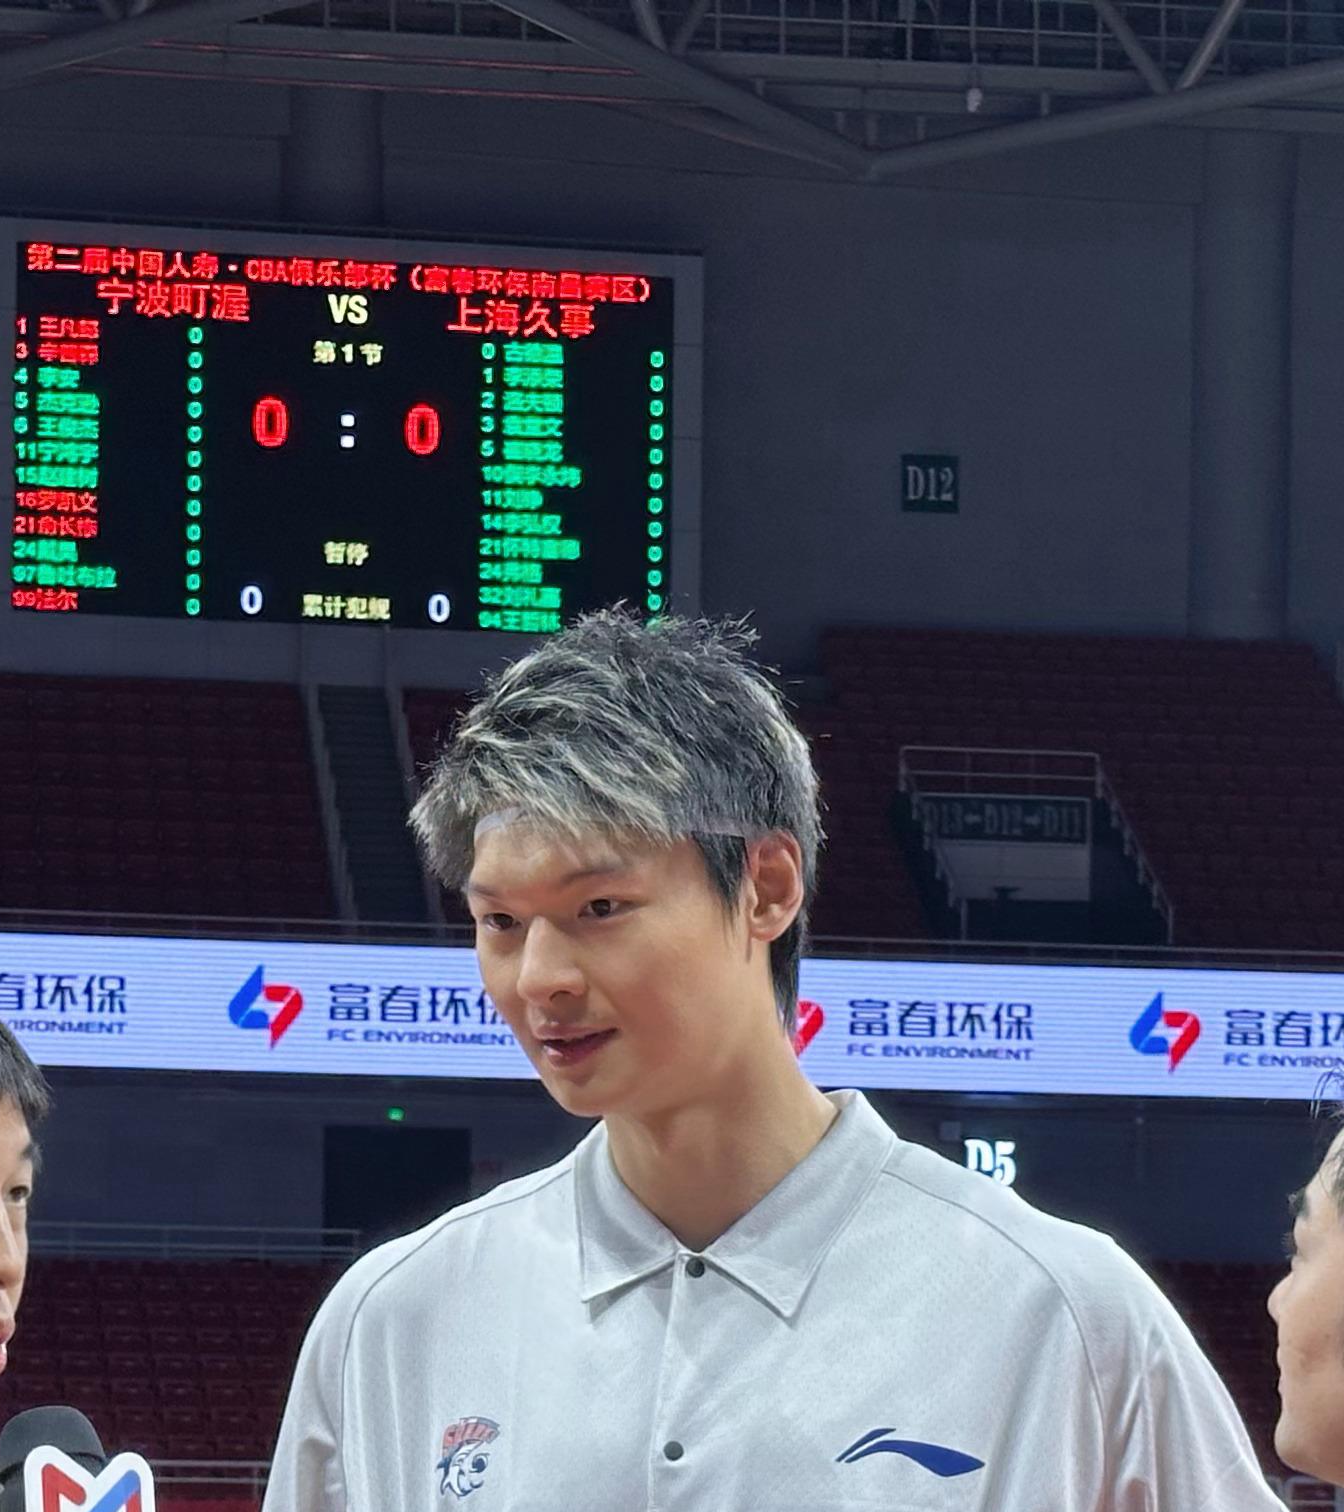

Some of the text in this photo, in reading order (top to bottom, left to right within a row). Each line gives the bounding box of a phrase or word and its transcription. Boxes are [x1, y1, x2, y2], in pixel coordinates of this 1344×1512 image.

[96, 277, 251, 322] 宁波町渥
[327, 293, 369, 325] VS
[447, 297, 596, 338] 上海久事
[15, 316, 27, 335] 1
[187, 326, 204, 345] 0
[15, 341, 29, 359] 3
[187, 351, 204, 369] 0
[649, 350, 665, 369] 0
[187, 375, 203, 395] 0
[482, 367, 493, 384] 1
[649, 374, 664, 393] 0
[187, 401, 203, 419] 0
[480, 391, 495, 409] 2
[649, 399, 664, 417] 0
[187, 425, 203, 444] 0
[252, 395, 289, 448] 0
[404, 402, 441, 455] 0
[480, 415, 495, 433] 3
[649, 423, 664, 441] 0
[187, 450, 203, 468] 0
[648, 447, 664, 465] 0
[186, 474, 203, 492] 0
[648, 471, 664, 490] 0
[906, 464, 955, 502] D12
[186, 499, 202, 517] 0
[647, 497, 664, 515] 0
[186, 523, 201, 543] 0
[647, 521, 663, 539] 0
[186, 548, 201, 567] 0
[323, 541, 369, 566] 暂停
[647, 545, 663, 563] 0
[186, 573, 201, 591] 0
[647, 569, 663, 587] 0
[185, 597, 201, 616] 0
[240, 585, 451, 623] 0 累计犯规 0
[647, 593, 663, 612] 0
[848, 998, 1034, 1041] 富春环保
[327, 1028, 357, 1042] FC
[847, 1042, 1035, 1061] FC ENVIRONMENT
[1223, 1052, 1253, 1067] FC
[964, 1138, 1016, 1187] D5
